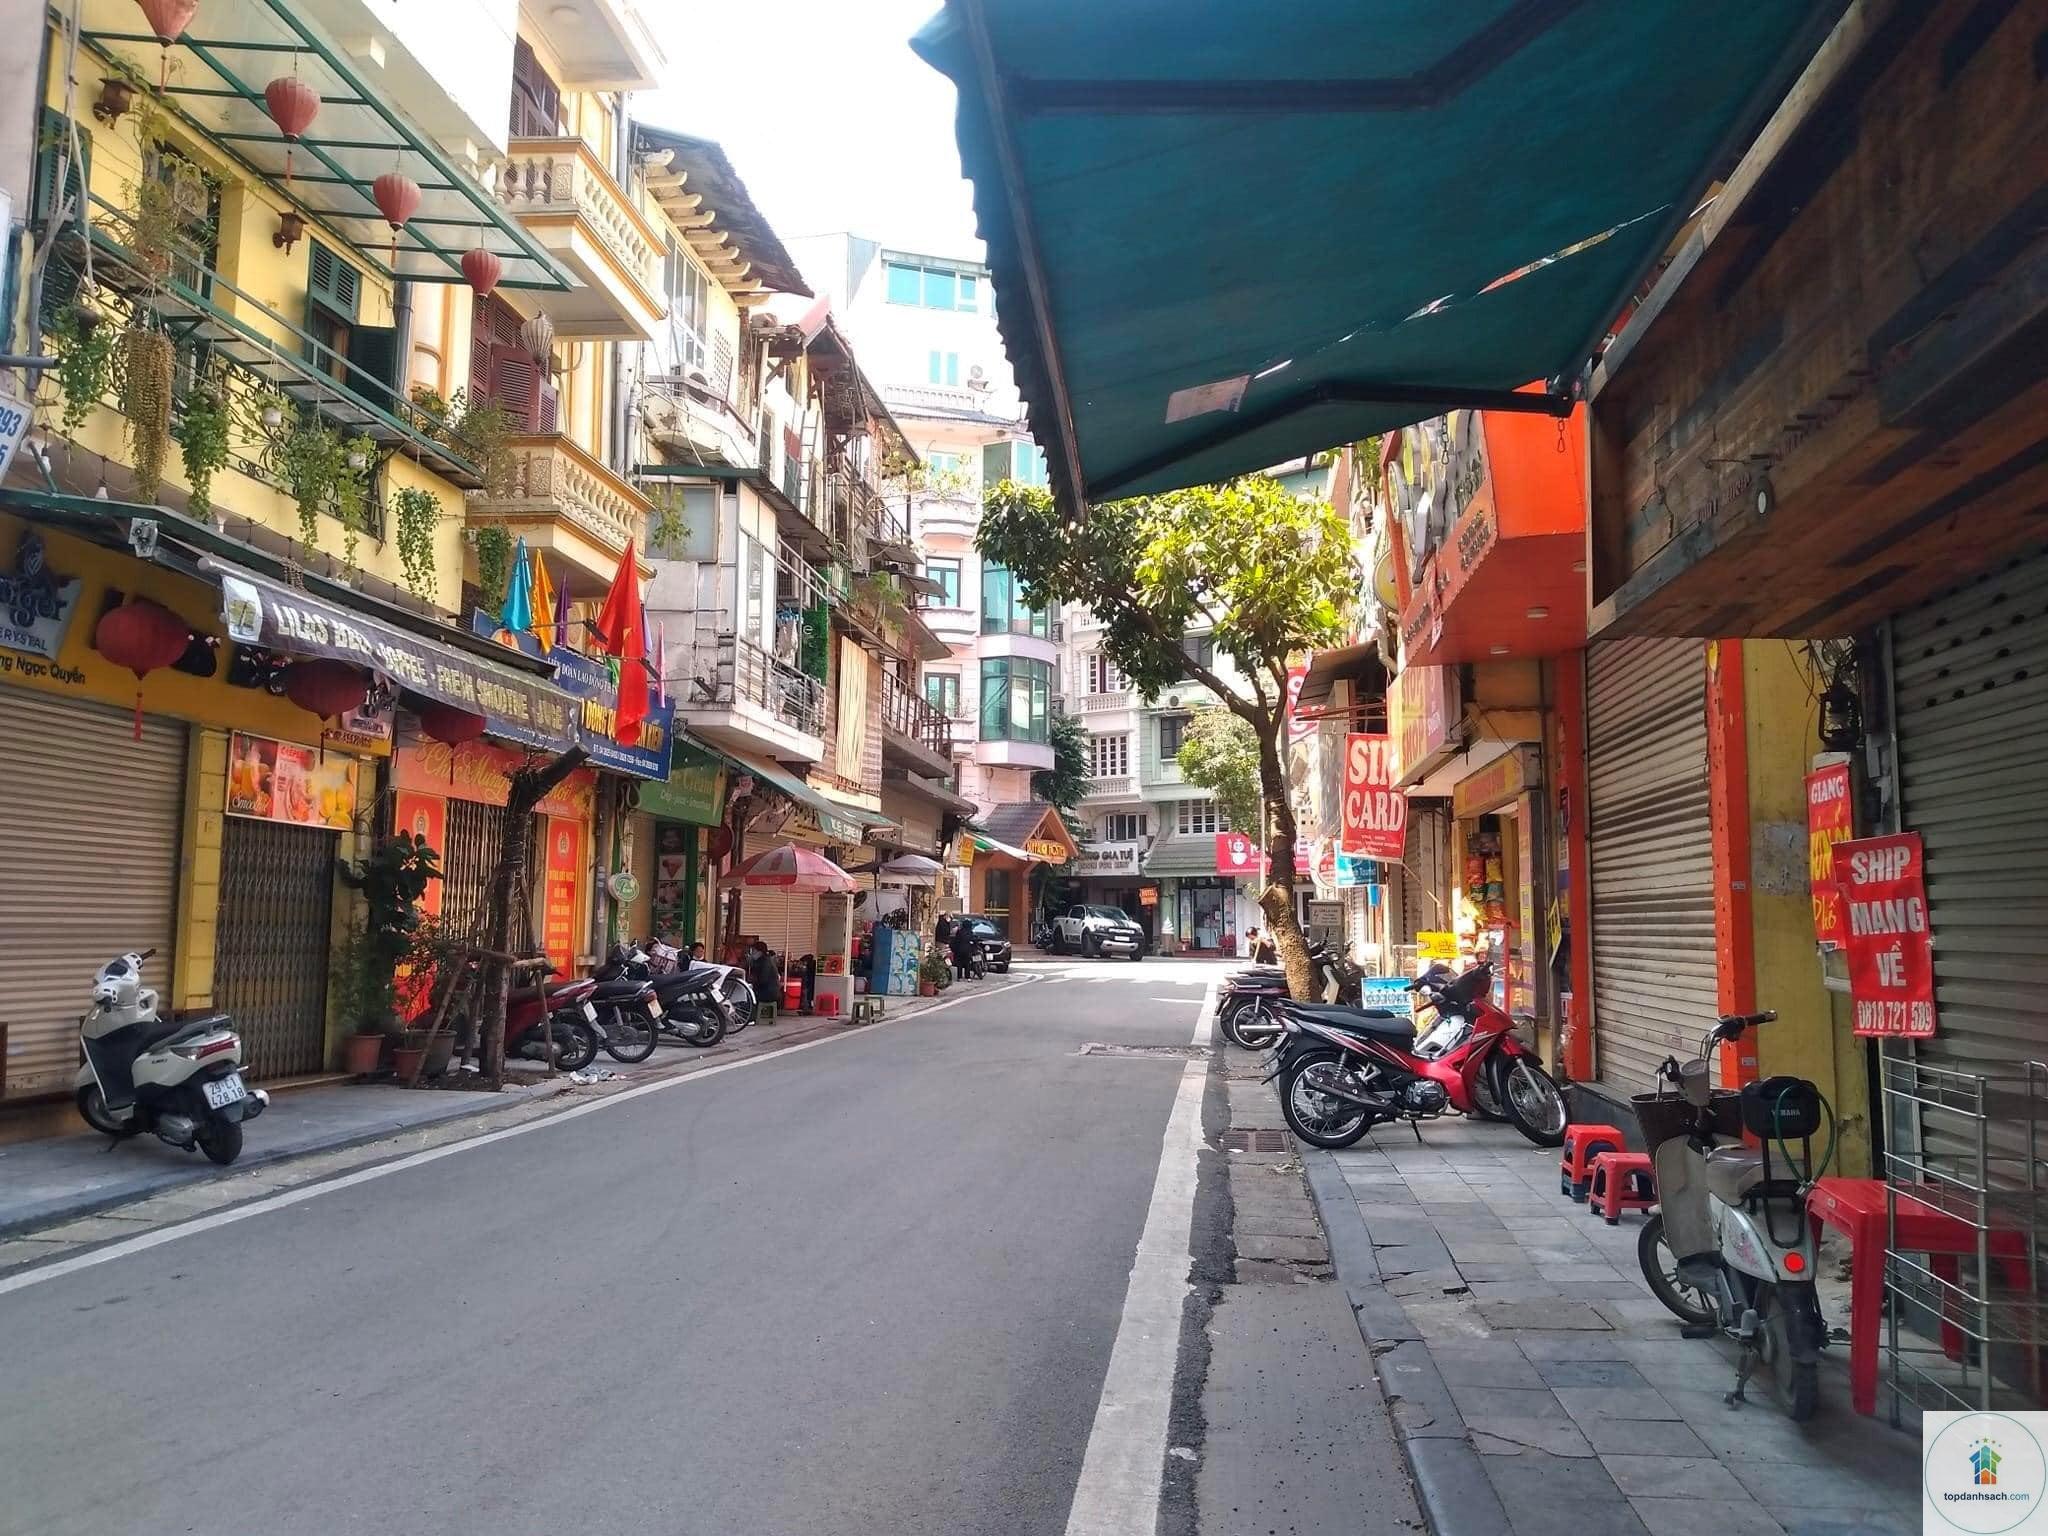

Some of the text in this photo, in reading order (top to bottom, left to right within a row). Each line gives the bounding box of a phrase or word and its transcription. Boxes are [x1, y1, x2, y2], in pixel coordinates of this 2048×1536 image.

[16, 656, 47, 678] Ngọc
[1346, 789, 1404, 831] CARD
[1811, 776, 1844, 805] GIANG
[1851, 846, 1911, 885] SHIP
[1851, 896, 1925, 936] MANG
[1876, 940, 1907, 987] VỀ
[1857, 1000, 1933, 1031] 0818 721 589
